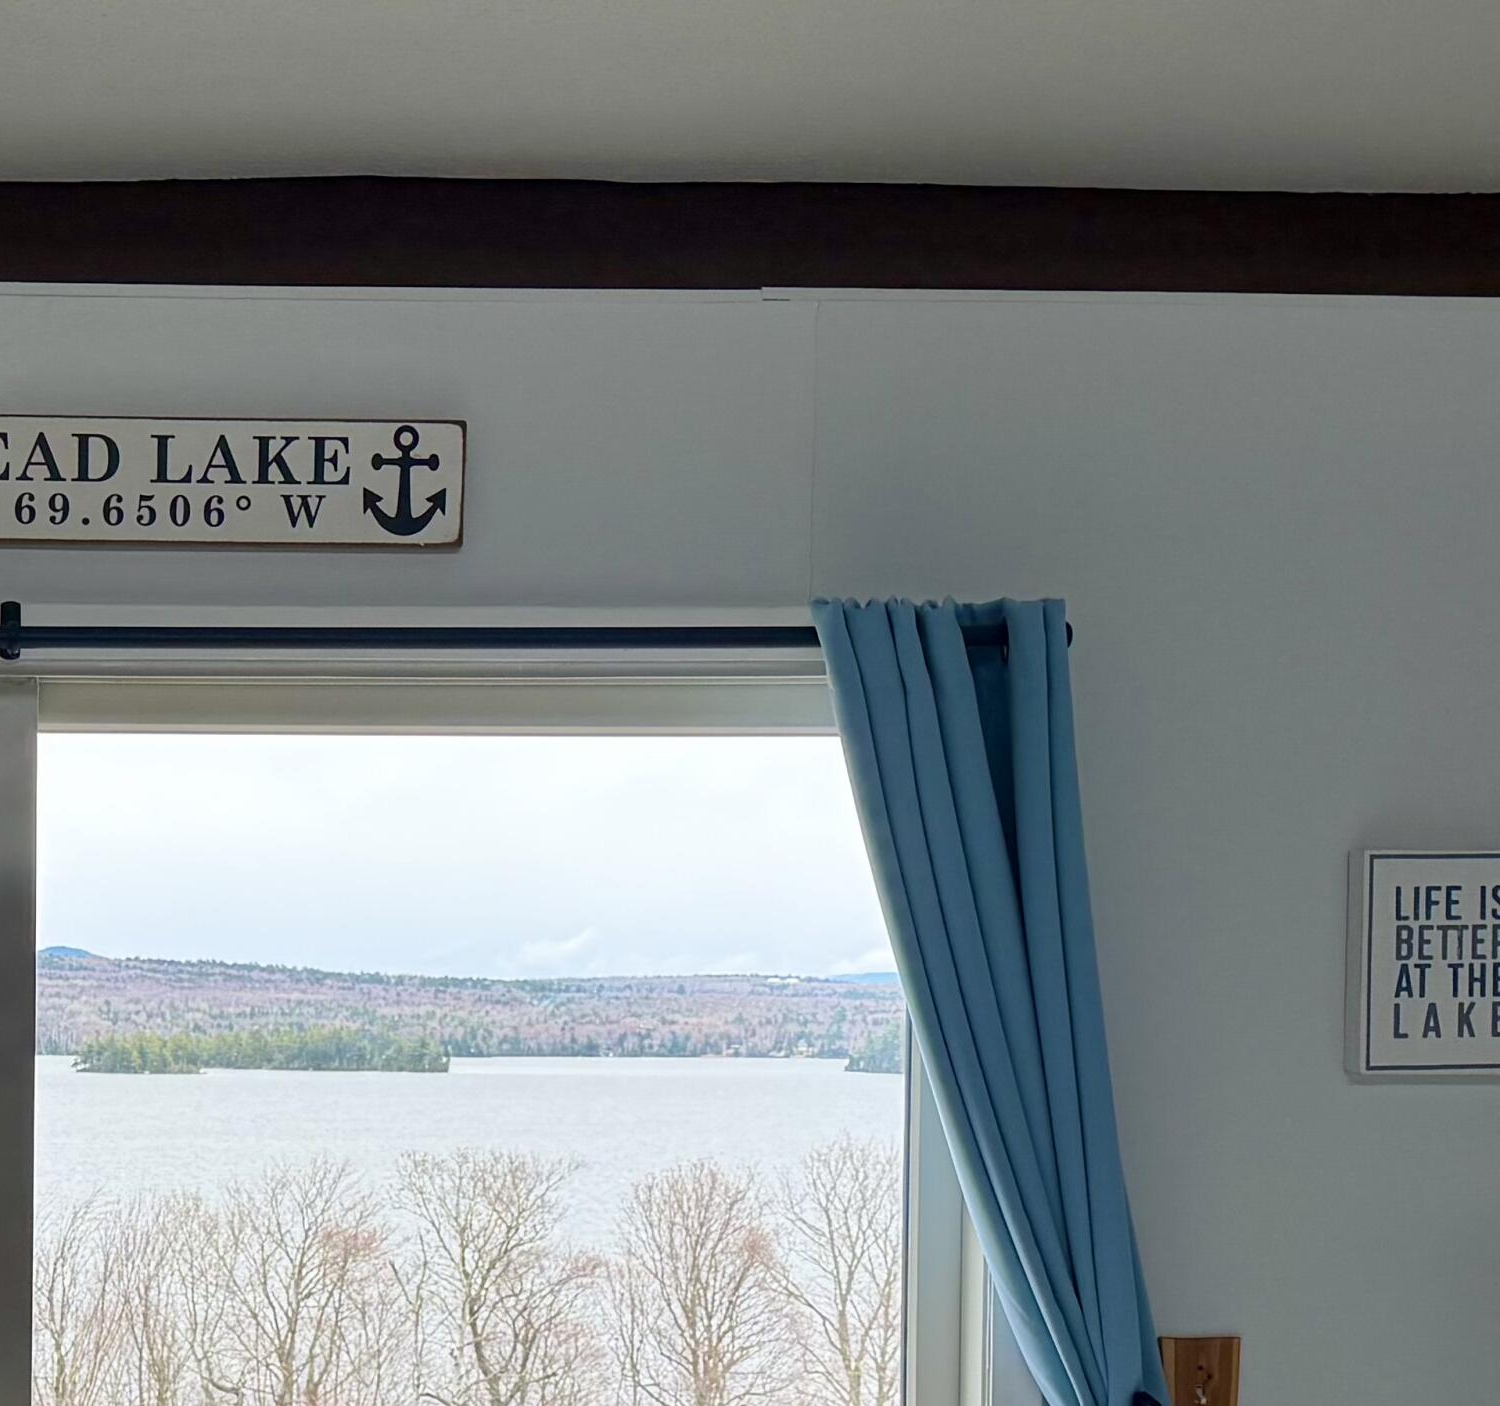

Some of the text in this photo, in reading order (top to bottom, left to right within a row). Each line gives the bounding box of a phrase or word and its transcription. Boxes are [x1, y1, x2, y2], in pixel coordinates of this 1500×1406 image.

[149, 434, 351, 486] LAKE
[14, 492, 252, 528] 69.6506°
[279, 494, 327, 529] W
[1395, 885, 1463, 922] LIFE
[1394, 963, 1432, 999] AT
